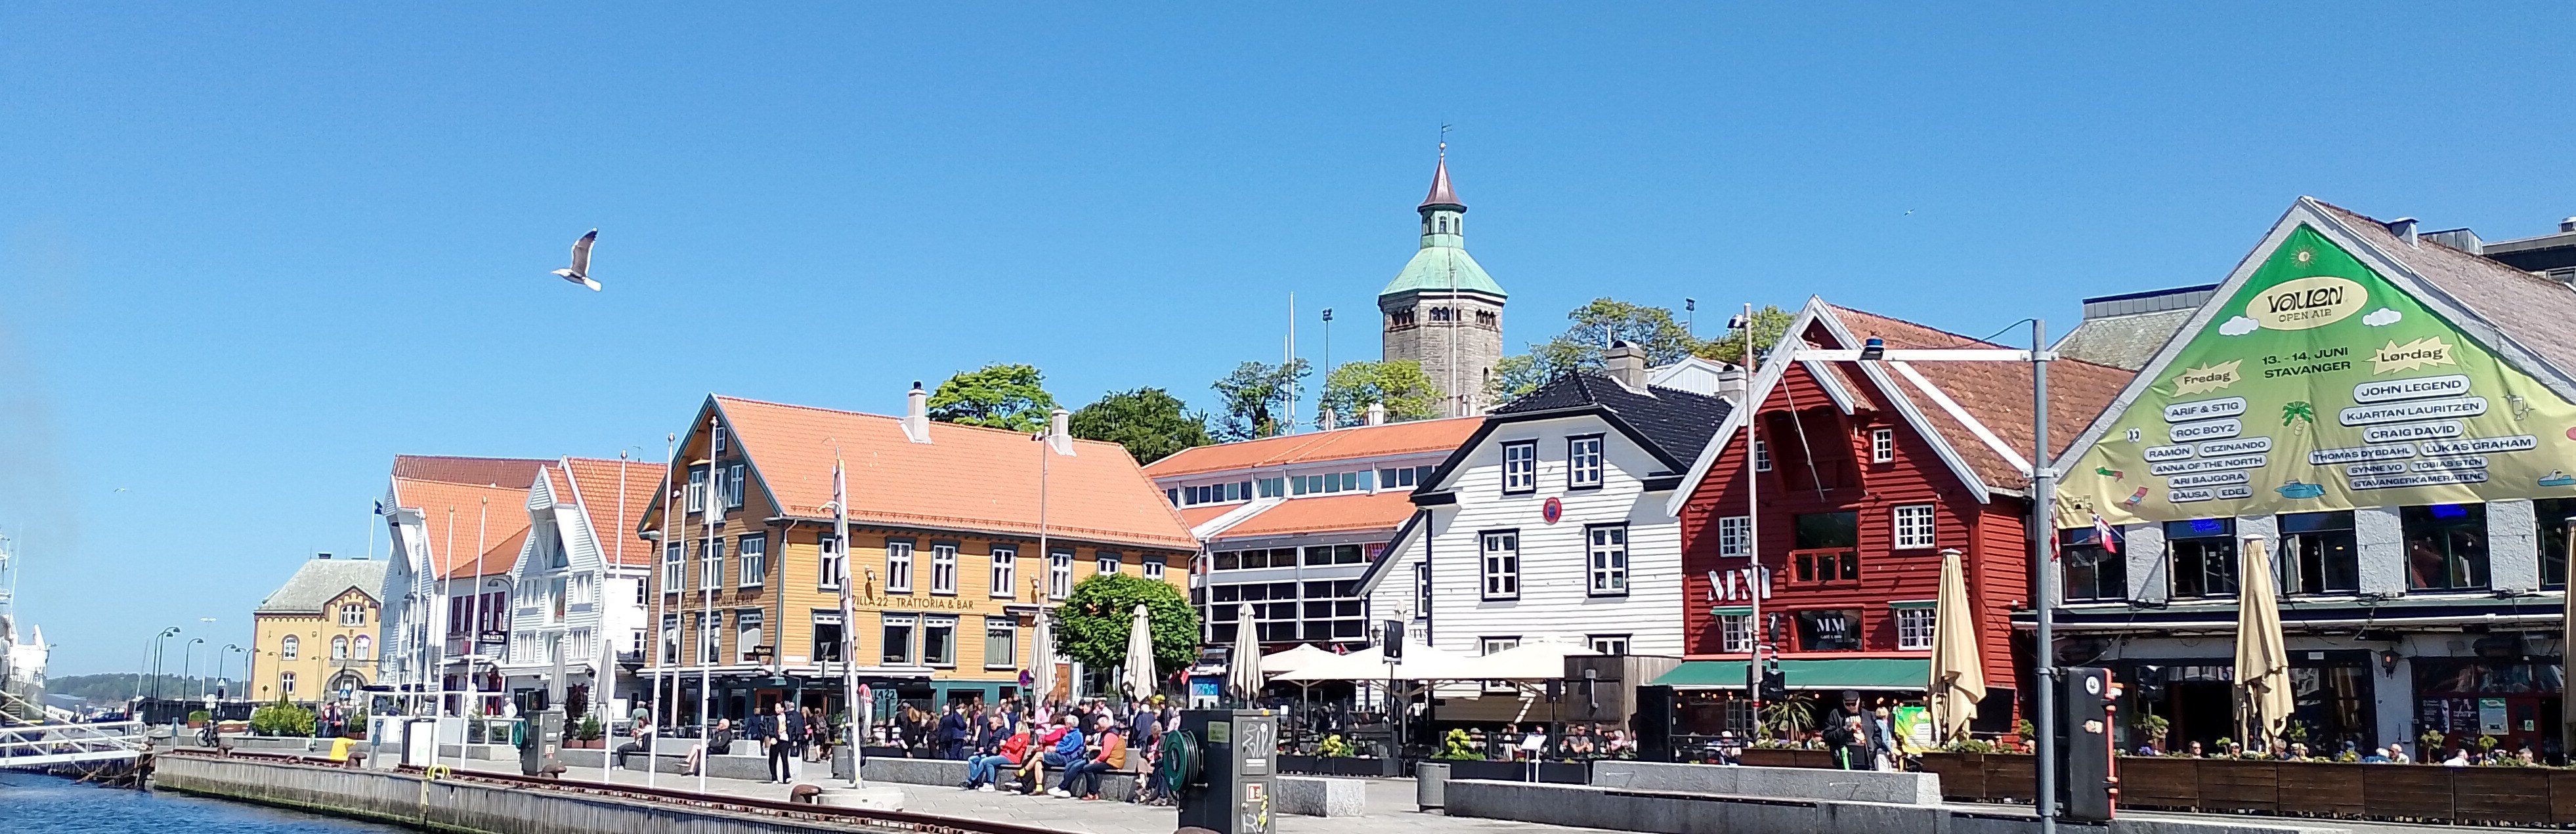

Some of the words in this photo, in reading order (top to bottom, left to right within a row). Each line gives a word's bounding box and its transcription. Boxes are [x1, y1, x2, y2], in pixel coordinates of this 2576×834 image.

[2279, 311, 2309, 323] OPEN
[2311, 308, 2332, 319] AIR
[2262, 355, 2281, 365] 13.
[2291, 352, 2311, 362] 14.
[2314, 346, 2349, 359] JUNI
[2380, 348, 2443, 362] Lørdag
[2264, 361, 2351, 379] STAVANGER
[2183, 371, 2231, 385] Fredag
[2361, 385, 2401, 396] JOHN
[2405, 379, 2462, 392] LEGEND
[2171, 406, 2197, 417] ARIF
[2212, 402, 2239, 412] STIG
[2346, 407, 2405, 421] KJARTAN
[2408, 402, 2479, 415] LAURITZEN
[2176, 428, 2200, 438] ROC
[2202, 424, 2236, 434] BOYZ
[2371, 428, 2412, 439] CRAIG
[2415, 425, 2455, 436] DAVID
[2149, 446, 2190, 458] RAMÓN
[2203, 440, 2266, 453] CEZINANDO
[2426, 442, 2469, 453] LUKAS
[2472, 438, 2532, 450] GRAHAM
[2314, 451, 2359, 462] THOMAS
[2155, 464, 2185, 472] ANNA
[2225, 457, 2263, 467] NORTH
[2351, 465, 2386, 474] SYNNE
[2192, 473, 2246, 484] BAJGORA
[2173, 491, 2210, 499] BAUSA
[1707, 568, 1772, 600] MM
[877, 596, 889, 607] 22
[896, 597, 945, 609] TRATTORIA
[948, 599, 954, 609] &
[956, 600, 974, 610] BAR
[1816, 617, 1846, 633] MM
